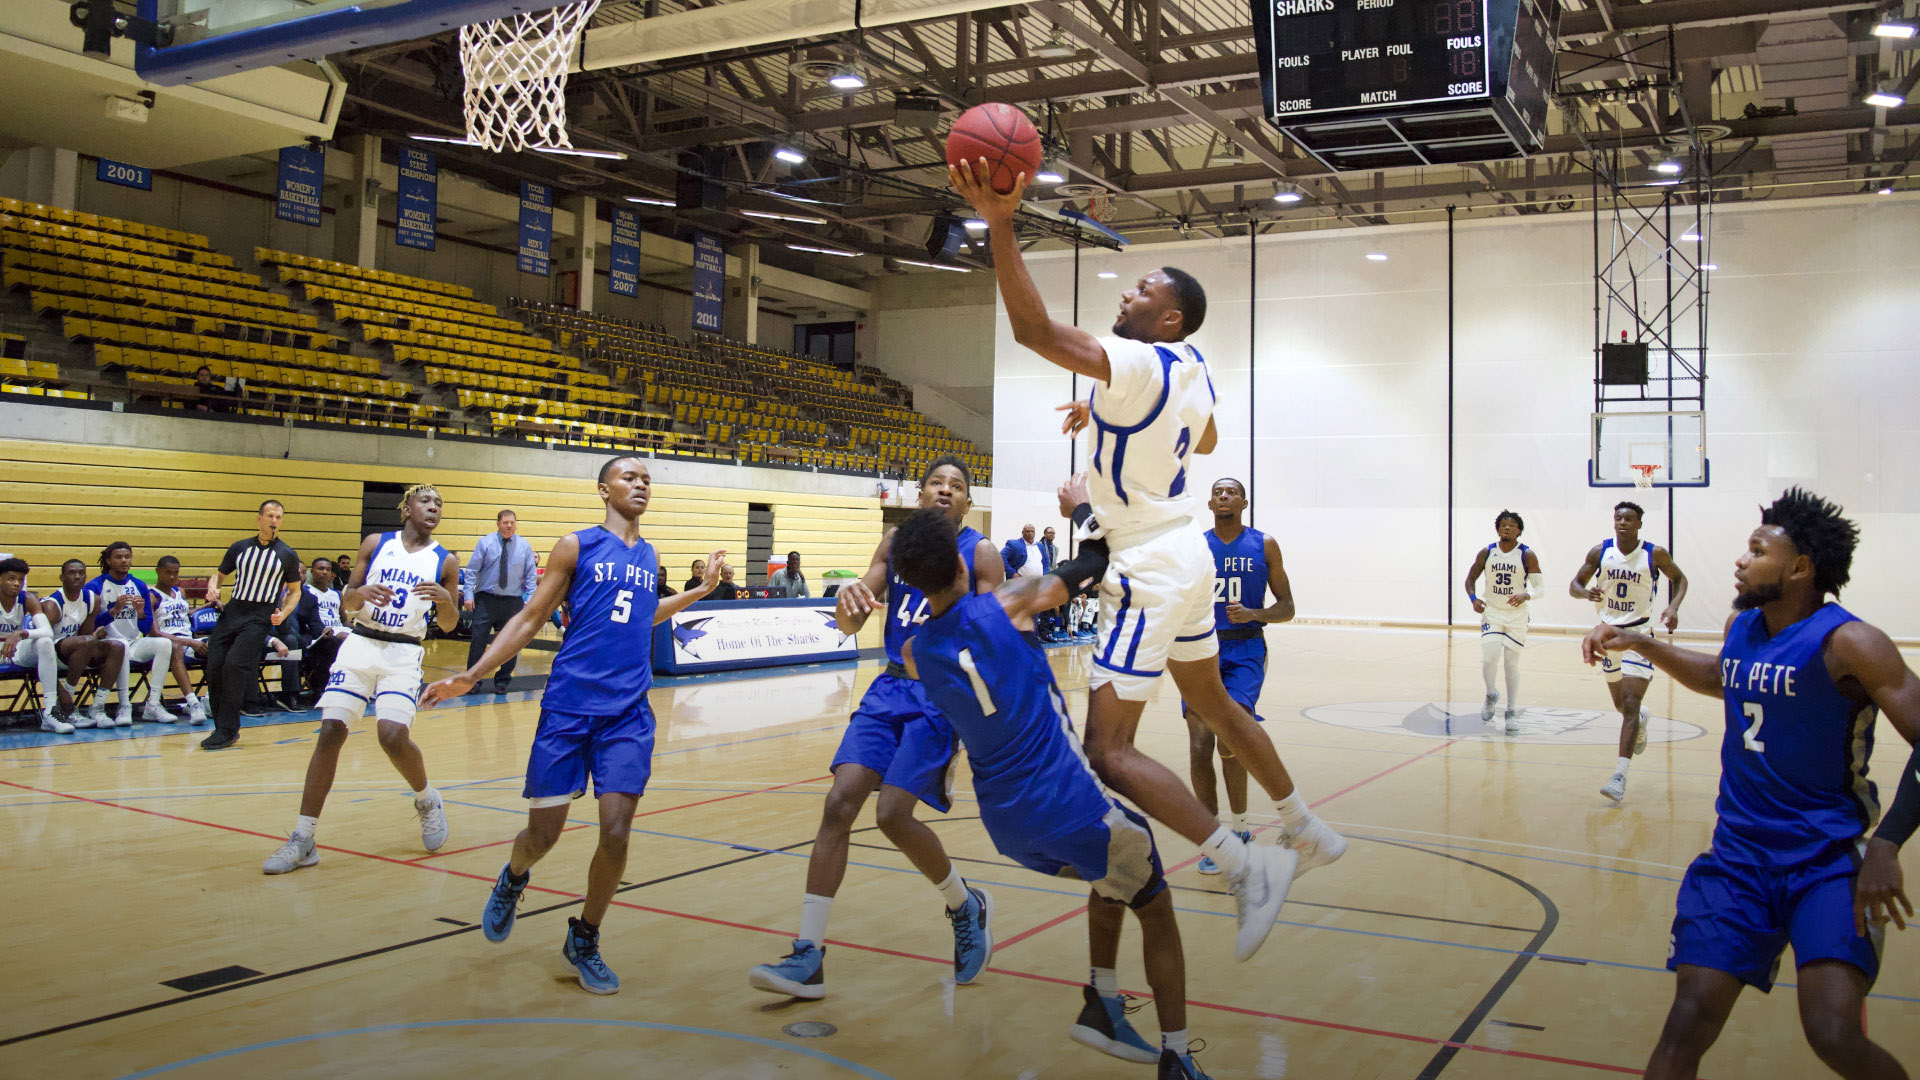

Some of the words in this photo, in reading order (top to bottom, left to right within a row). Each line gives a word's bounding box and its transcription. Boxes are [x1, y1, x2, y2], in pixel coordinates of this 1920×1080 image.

[1277, 0, 1335, 16] SHARKS
[1357, 0, 1394, 10] PERIOD
[1447, 36, 1482, 49] FOULS
[1342, 48, 1380, 61] PLAYER
[1387, 44, 1414, 56] FOUL
[1279, 55, 1310, 68] FOULS
[1448, 81, 1483, 95] SCORE
[1361, 90, 1397, 104] MATCH
[1280, 99, 1312, 111] SCORE
[409, 160, 427, 171] STATE
[107, 165, 144, 183] 2001
[400, 168, 437, 183] CHAMPIONS
[286, 179, 316, 196] WOMEN'S
[280, 189, 320, 207] BASKETBALL
[404, 208, 431, 222] WOMEN'S
[400, 218, 434, 233] BASKETBALL
[520, 246, 550, 260] BASKETBALL
[613, 280, 635, 293] 2007
[696, 312, 719, 329] 2011
[1224, 557, 1254, 572] PETE
[1491, 563, 1517, 574] MIAMI
[380, 567, 425, 588] MIAM
[594, 562, 618, 583] ST.
[625, 563, 656, 593] PETE
[1495, 573, 1511, 586] 35
[1607, 568, 1642, 584] MIAMI
[125, 586, 136, 595] 22
[389, 585, 409, 610] 3
[1214, 576, 1242, 604] 20
[1492, 584, 1514, 596] DADE
[1615, 582, 1628, 599] 0
[328, 608, 337, 619] 4
[611, 589, 634, 625] 5
[897, 593, 931, 628] 44
[1606, 599, 1636, 613] DADE
[164, 618, 186, 629] DADE
[199, 611, 222, 624] SHAR
[370, 606, 408, 628] DADE
[0, 623, 22, 634] IAM
[60, 622, 80, 634] MIA
[717, 637, 746, 651] Home
[766, 634, 784, 648] The
[786, 631, 821, 646] Sharks
[958, 647, 998, 718] 1
[1721, 658, 1741, 689] ST.
[1748, 661, 1796, 697] PETE
[1742, 701, 1765, 753] 2
